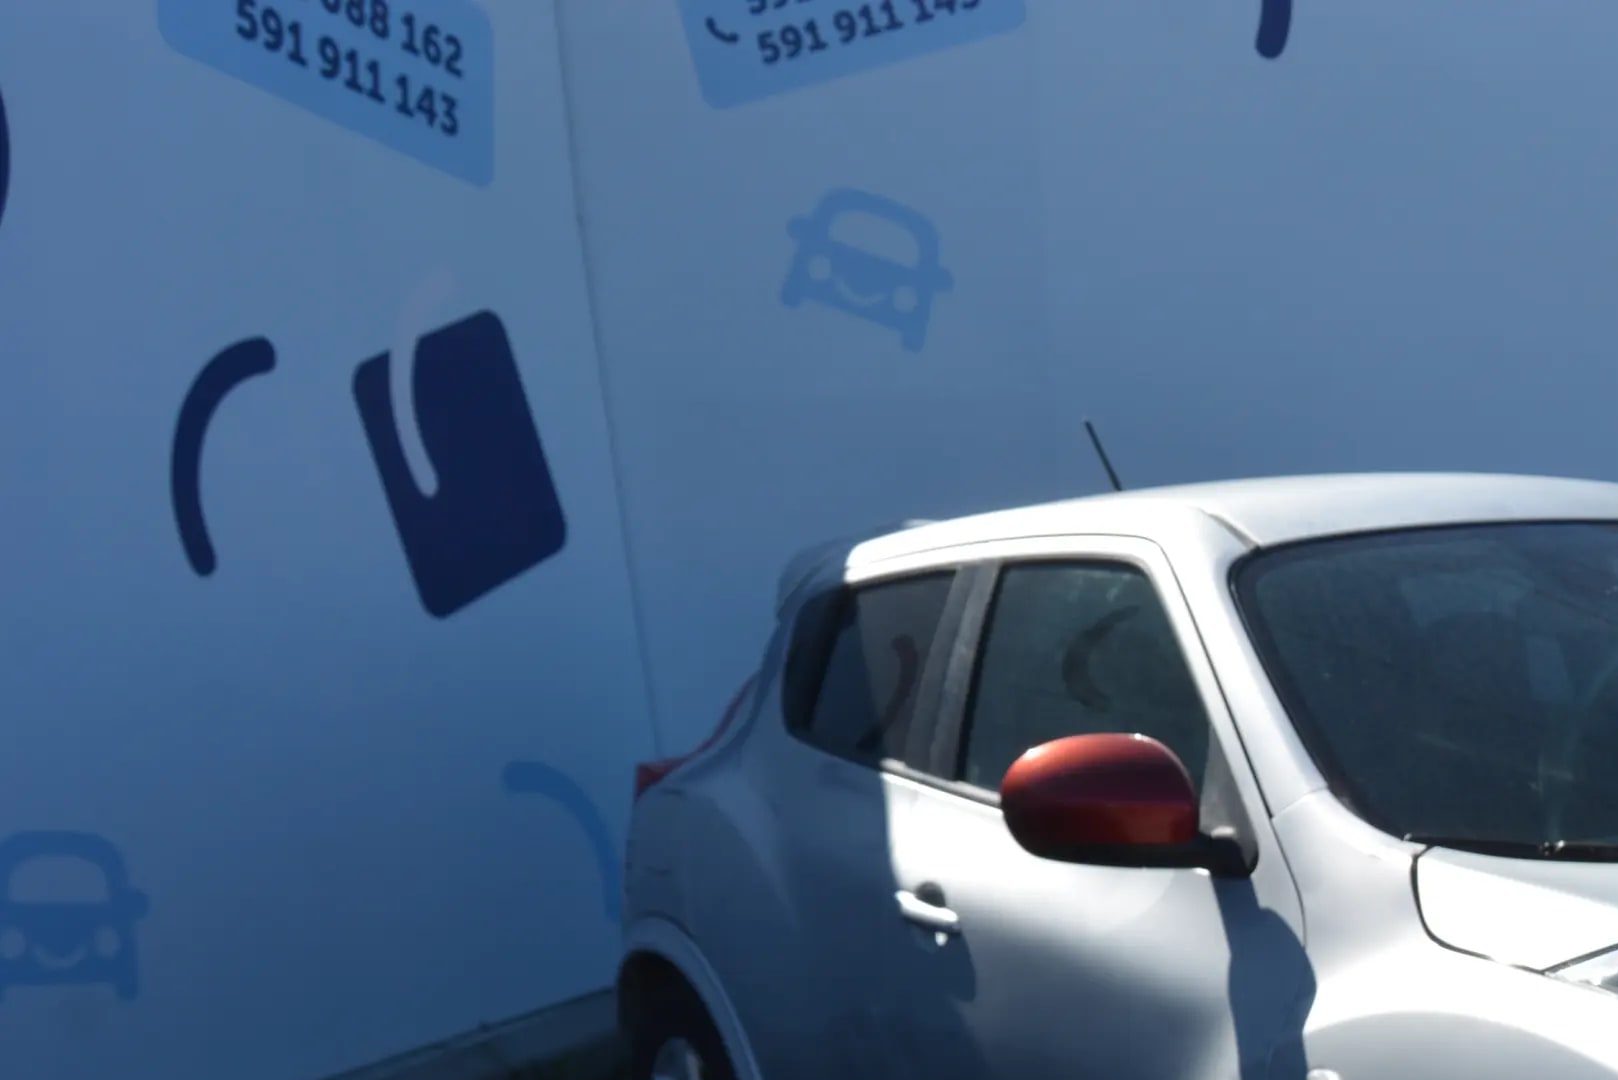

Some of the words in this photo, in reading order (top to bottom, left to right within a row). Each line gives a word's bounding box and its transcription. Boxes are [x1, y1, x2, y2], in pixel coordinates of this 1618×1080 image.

[400, 13, 463, 79] 162
[756, 19, 828, 65] 591
[832, 0, 904, 44] 911
[914, 0, 981, 23] 14
[235, 0, 308, 68] 591
[318, 35, 385, 104] 911
[395, 75, 459, 137] 143
